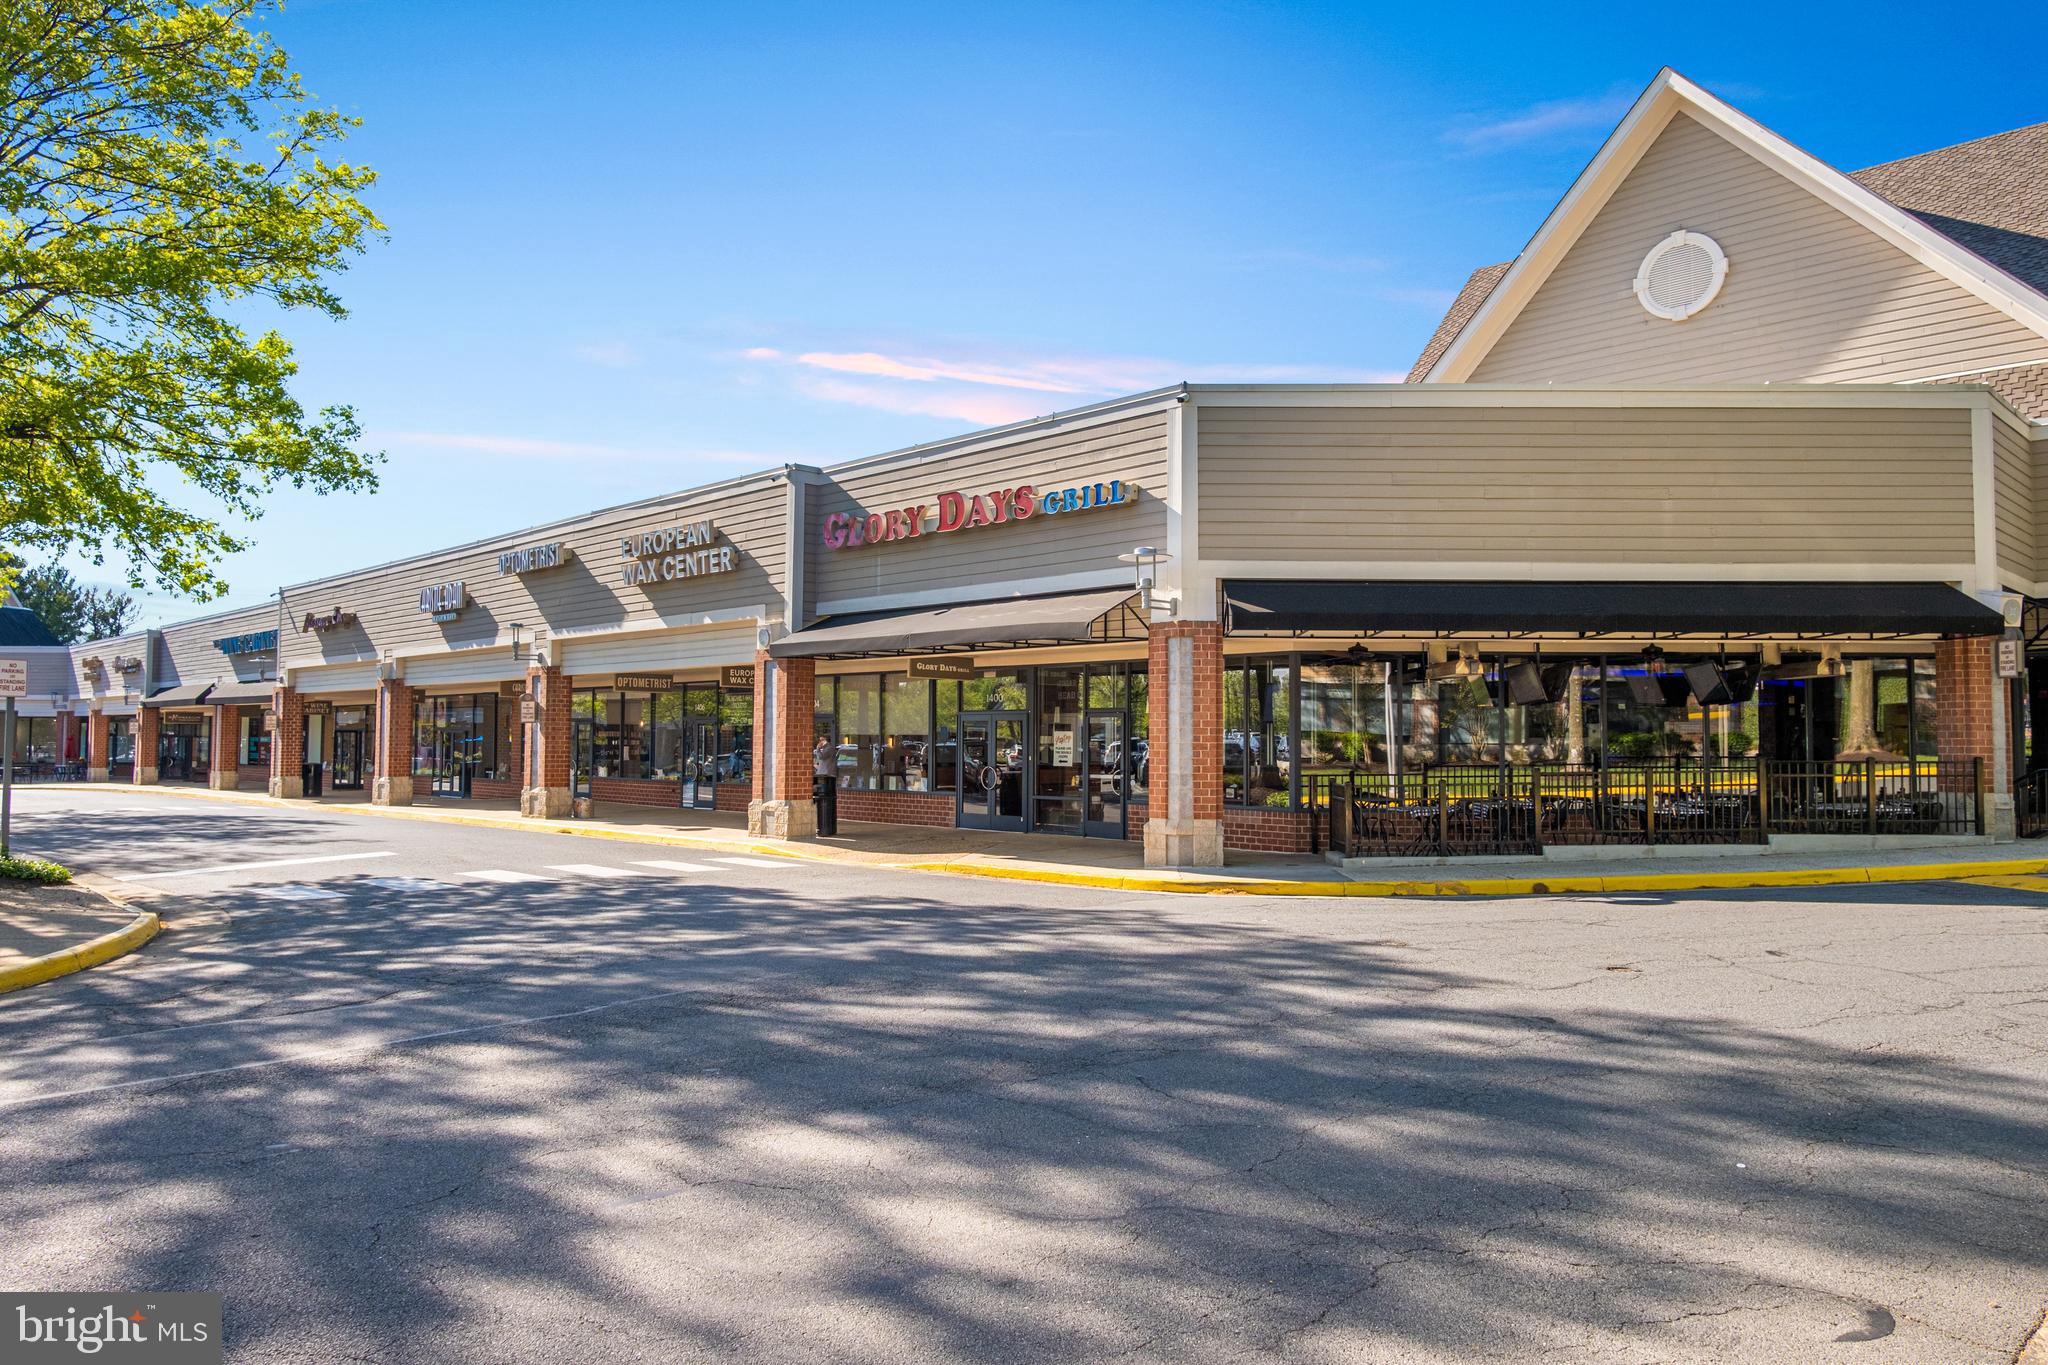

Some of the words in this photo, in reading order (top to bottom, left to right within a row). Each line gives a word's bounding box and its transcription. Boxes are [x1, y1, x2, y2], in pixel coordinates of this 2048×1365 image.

[822, 505, 926, 550] GLORY
[937, 485, 1036, 533] DAYS
[1043, 480, 1127, 515] GRILL
[621, 520, 711, 560] EUROPEAN
[498, 543, 562, 577] OPTOMETRIST
[621, 559, 658, 586] WAX
[663, 546, 733, 581] CENTER
[729, 668, 754, 677] EUROP
[916, 662, 938, 671] GLORY
[939, 664, 957, 672] DAYS
[617, 677, 672, 689] OPTOMETRIST
[729, 677, 747, 685] WAX
[986, 693, 1004, 703] 1400
